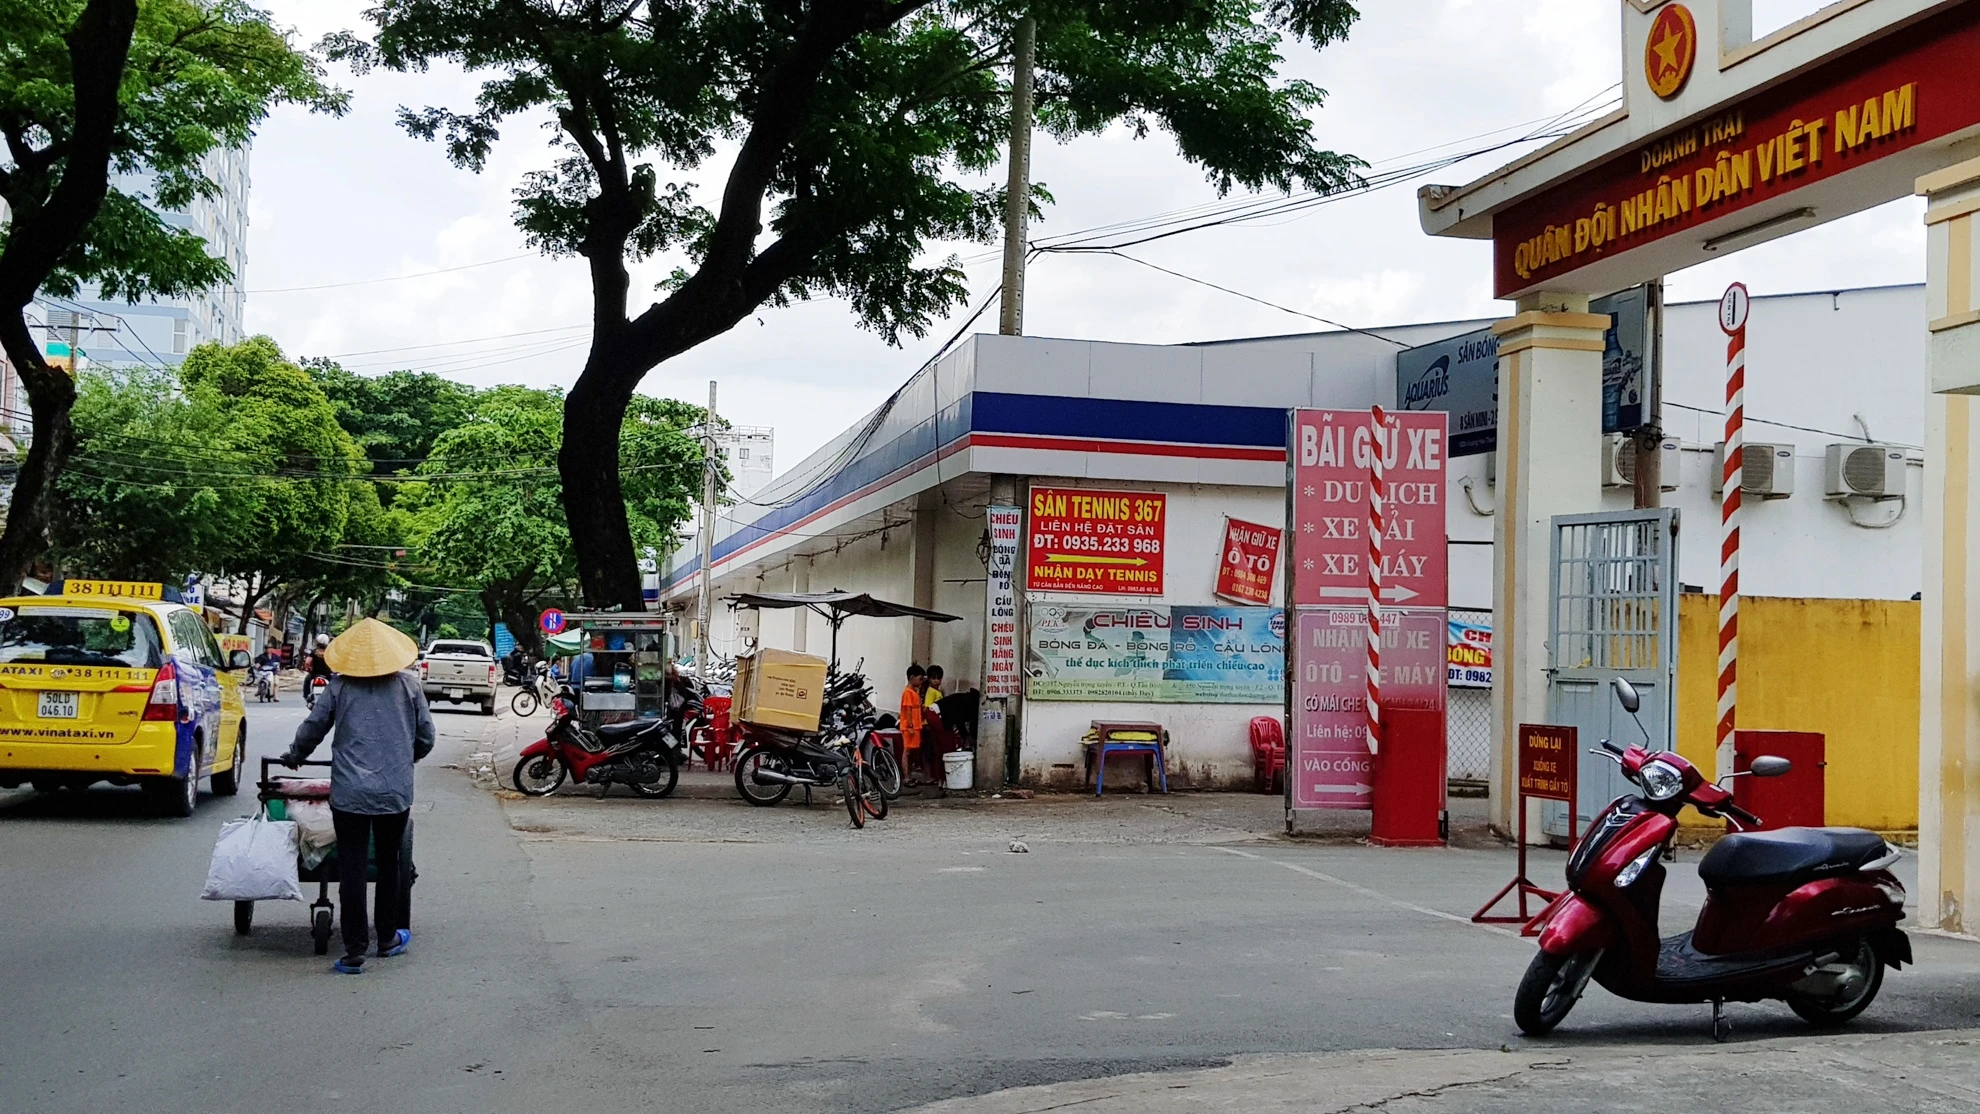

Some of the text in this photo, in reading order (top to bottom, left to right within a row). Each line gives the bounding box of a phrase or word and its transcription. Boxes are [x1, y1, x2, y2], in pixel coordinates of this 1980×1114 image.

[1641, 129, 1697, 173] DOANH
[1515, 224, 1572, 279] QUÂN
[1575, 202, 1616, 253] ĐỘI
[1620, 175, 1691, 236] NHÂN
[1695, 150, 1754, 208] DÂN
[1834, 82, 1917, 153] NAM
[1301, 412, 1441, 470] BÃI GỮ XE
[1323, 480, 1364, 503] DU
[1034, 490, 1162, 522] SÂN TENNIS 367
[991, 512, 1018, 525] CHIÊU
[1040, 520, 1155, 536] LIÊN HỆ ĐẶT SÂN
[1322, 517, 1359, 539] XE
[994, 528, 1015, 540] SINH
[1229, 525, 1277, 550] NHẬN GIỮ XE
[1034, 534, 1160, 554] ĐT: 0935.233 968
[1228, 547, 1271, 572] Ô TÔ
[1322, 554, 1359, 576] XE
[1034, 564, 1158, 583] NHẬN DẠY TENNIS
[70, 583, 155, 597] 38 111 111
[1094, 612, 1243, 631] CHIÊU SINH
[1331, 612, 1356, 624] 0989
[993, 636, 1012, 646] SINH
[1038, 638, 1081, 650] BÓNG
[1313, 626, 1363, 652] NHẬN
[1406, 630, 1430, 649] XE
[1085, 658, 1105, 670] dục
[1247, 662, 1265, 671] cao
[1305, 659, 1342, 684] ÔTÔ
[1394, 662, 1437, 685] MÁY
[74, 669, 92, 678] 38
[99, 669, 120, 679] 111
[127, 671, 149, 680] 111
[1465, 669, 1492, 683] 0982
[41, 704, 74, 717] 046.10
[1304, 694, 1319, 711] CÓ
[1320, 694, 1340, 712] MÁI
[1341, 696, 1361, 713] CHE
[1306, 723, 1331, 738] Liên
[1334, 723, 1353, 743] hệ:
[1528, 731, 1562, 753] DỪNG LẠI
[1303, 757, 1331, 771] VÀO
[1550, 761, 1557, 773] XE
